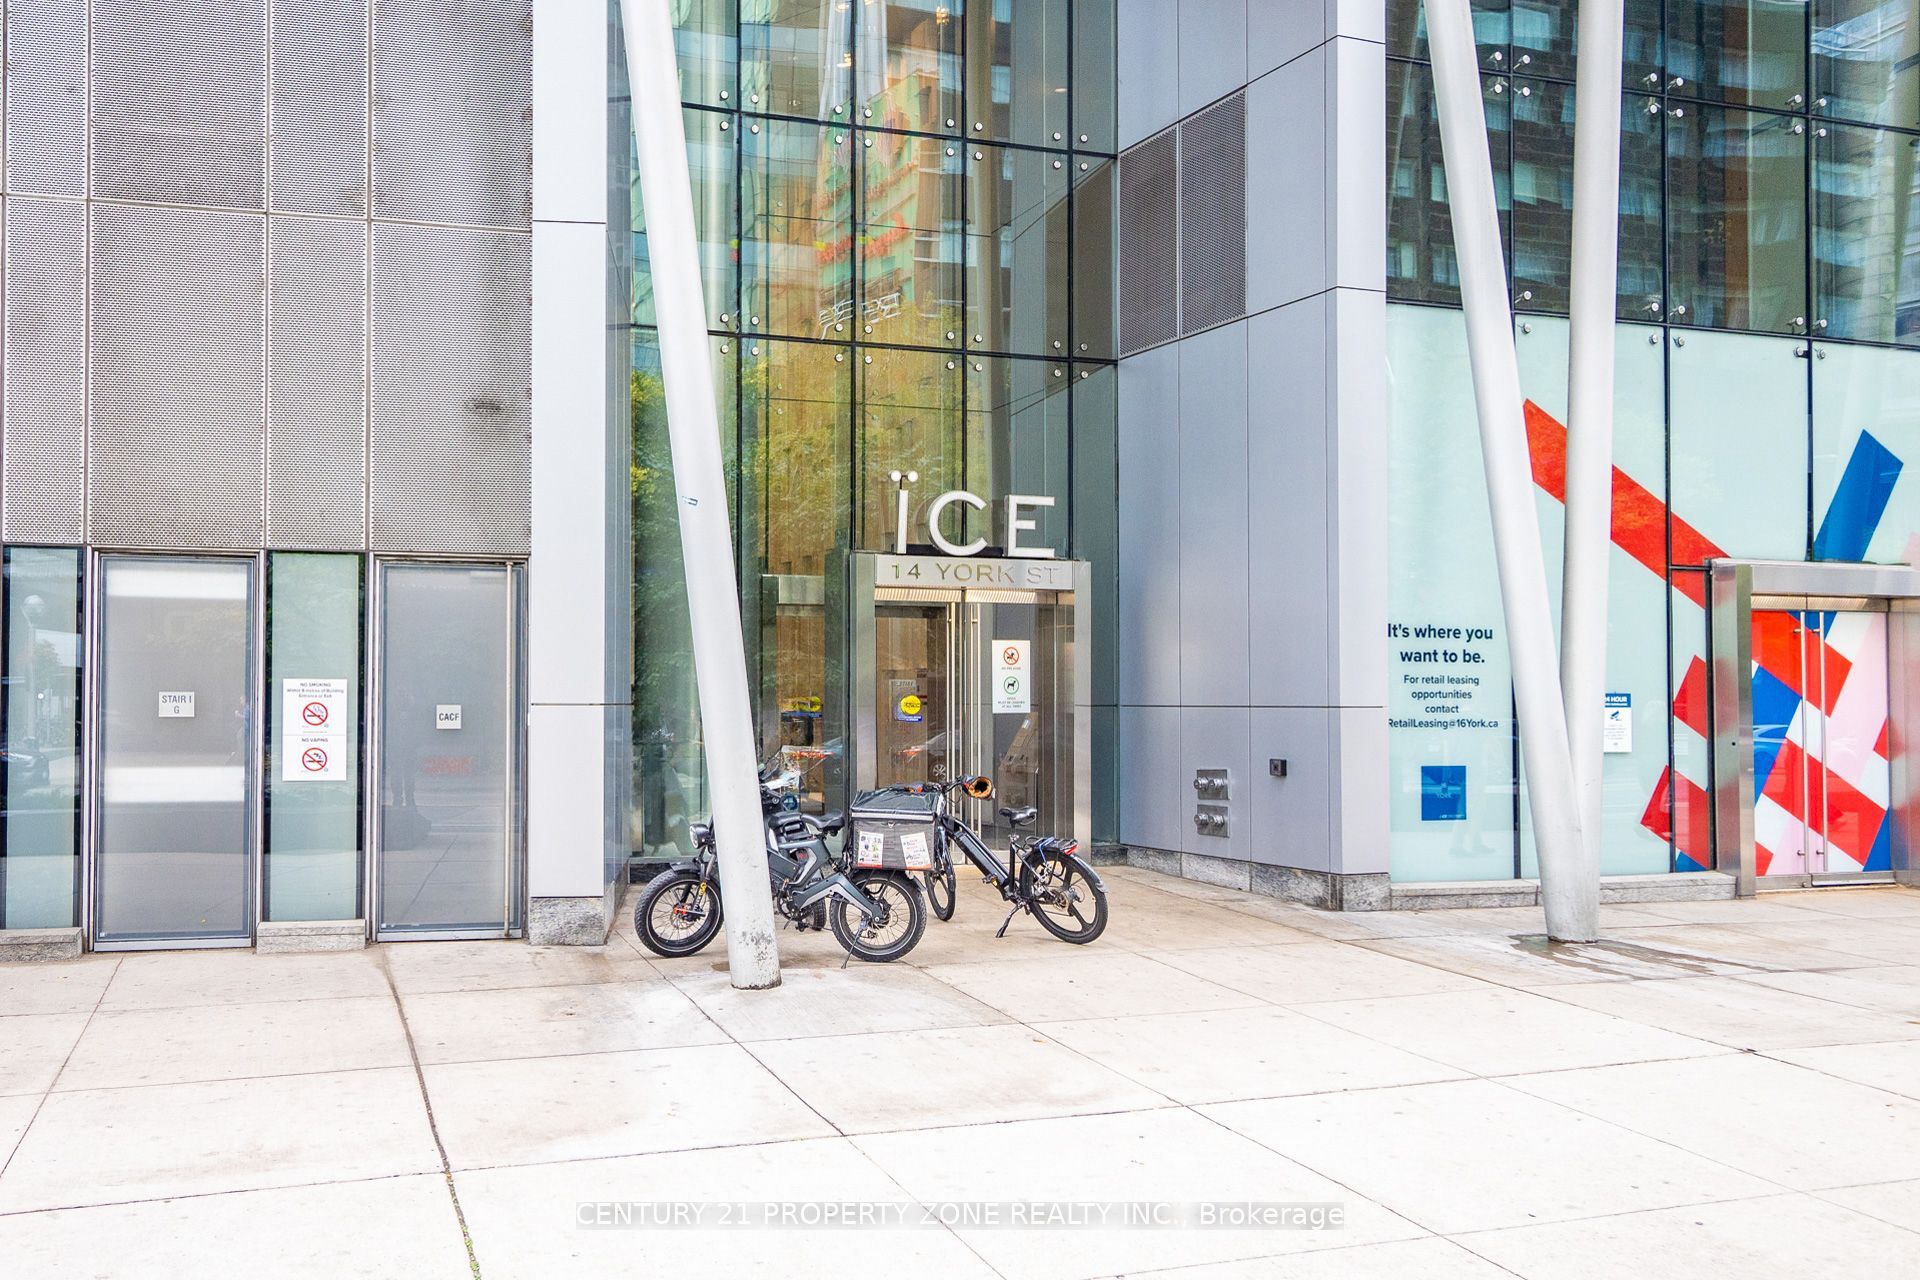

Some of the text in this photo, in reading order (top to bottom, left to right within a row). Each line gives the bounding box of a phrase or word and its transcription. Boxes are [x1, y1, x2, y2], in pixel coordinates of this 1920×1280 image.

[891, 563, 1059, 585] 14 YORK ST
[1387, 623, 1493, 643] It's where you
[1400, 649, 1485, 663] want to be.
[1404, 674, 1480, 686] For retail leasing
[161, 695, 187, 704] STAIR
[1411, 689, 1472, 700] opportunities
[173, 705, 180, 714] G
[1425, 704, 1459, 713] contact
[438, 712, 460, 722] CACF
